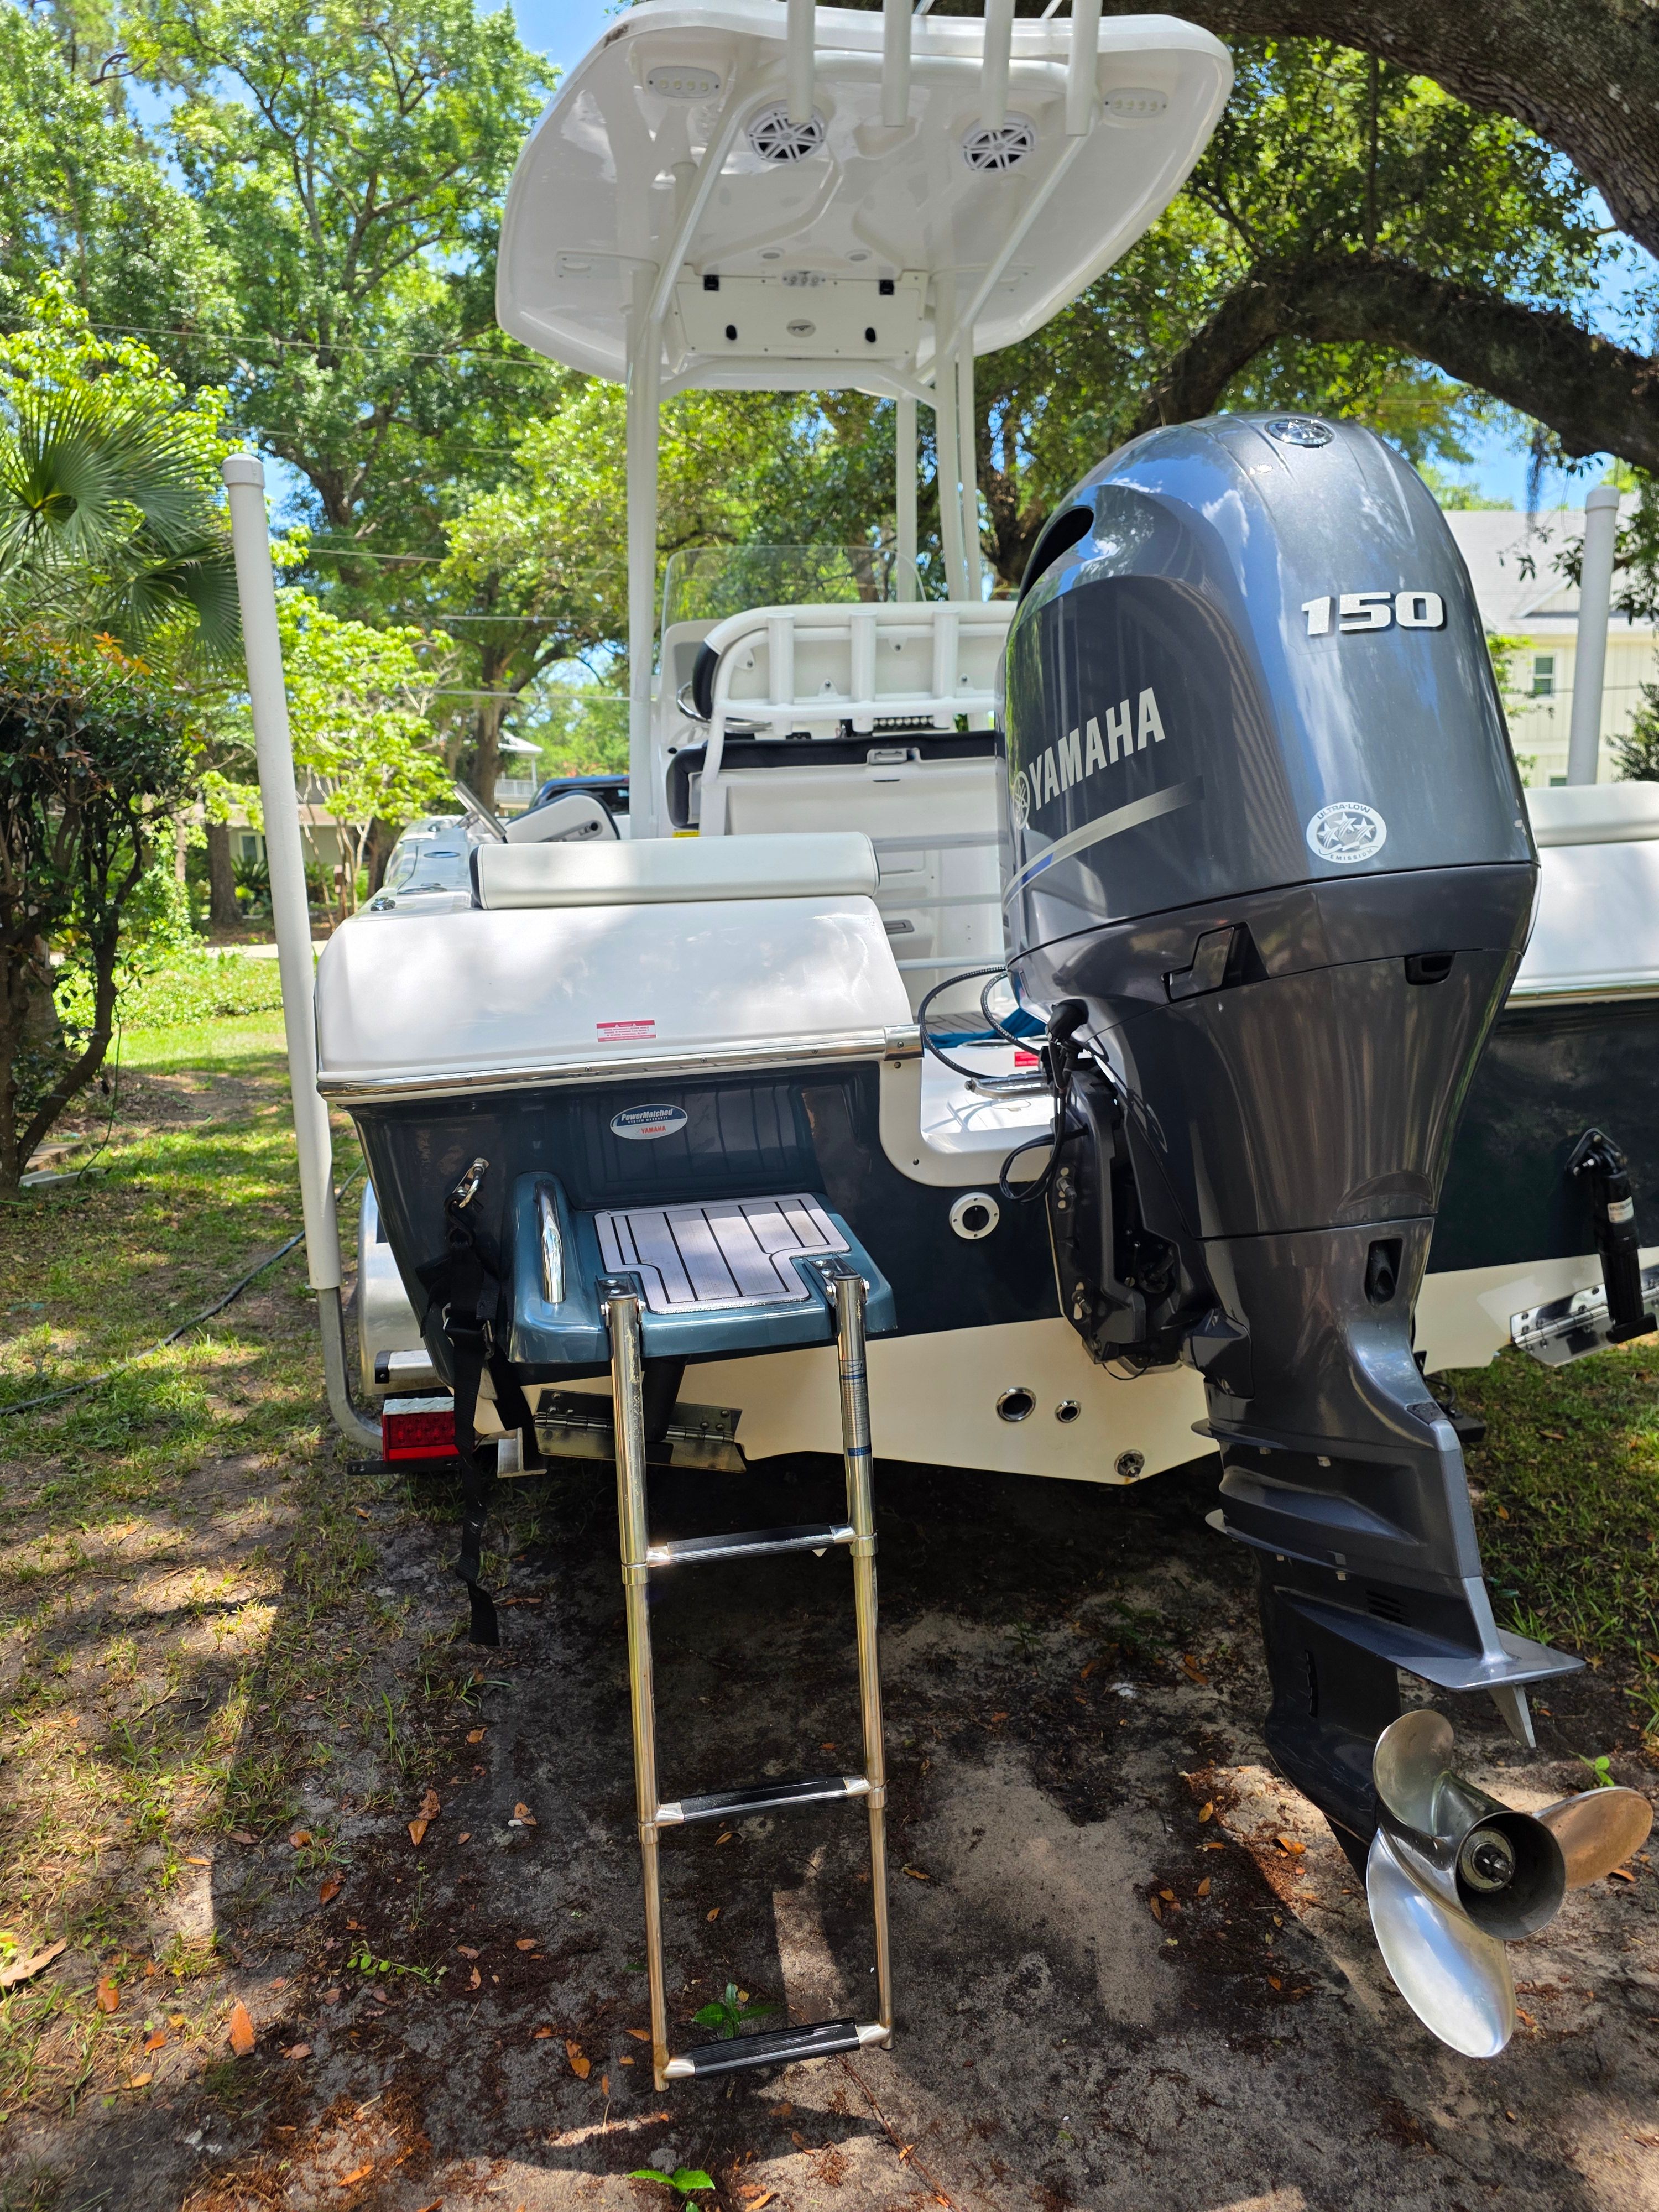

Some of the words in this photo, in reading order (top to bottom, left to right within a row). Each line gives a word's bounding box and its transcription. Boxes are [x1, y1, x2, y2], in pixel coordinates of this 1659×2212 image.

[1301, 591, 1444, 635] 150
[1028, 687, 1166, 811] YAMAHA
[1330, 849, 1373, 860] EMISSION
[641, 1125, 666, 1134] YAMAHA
